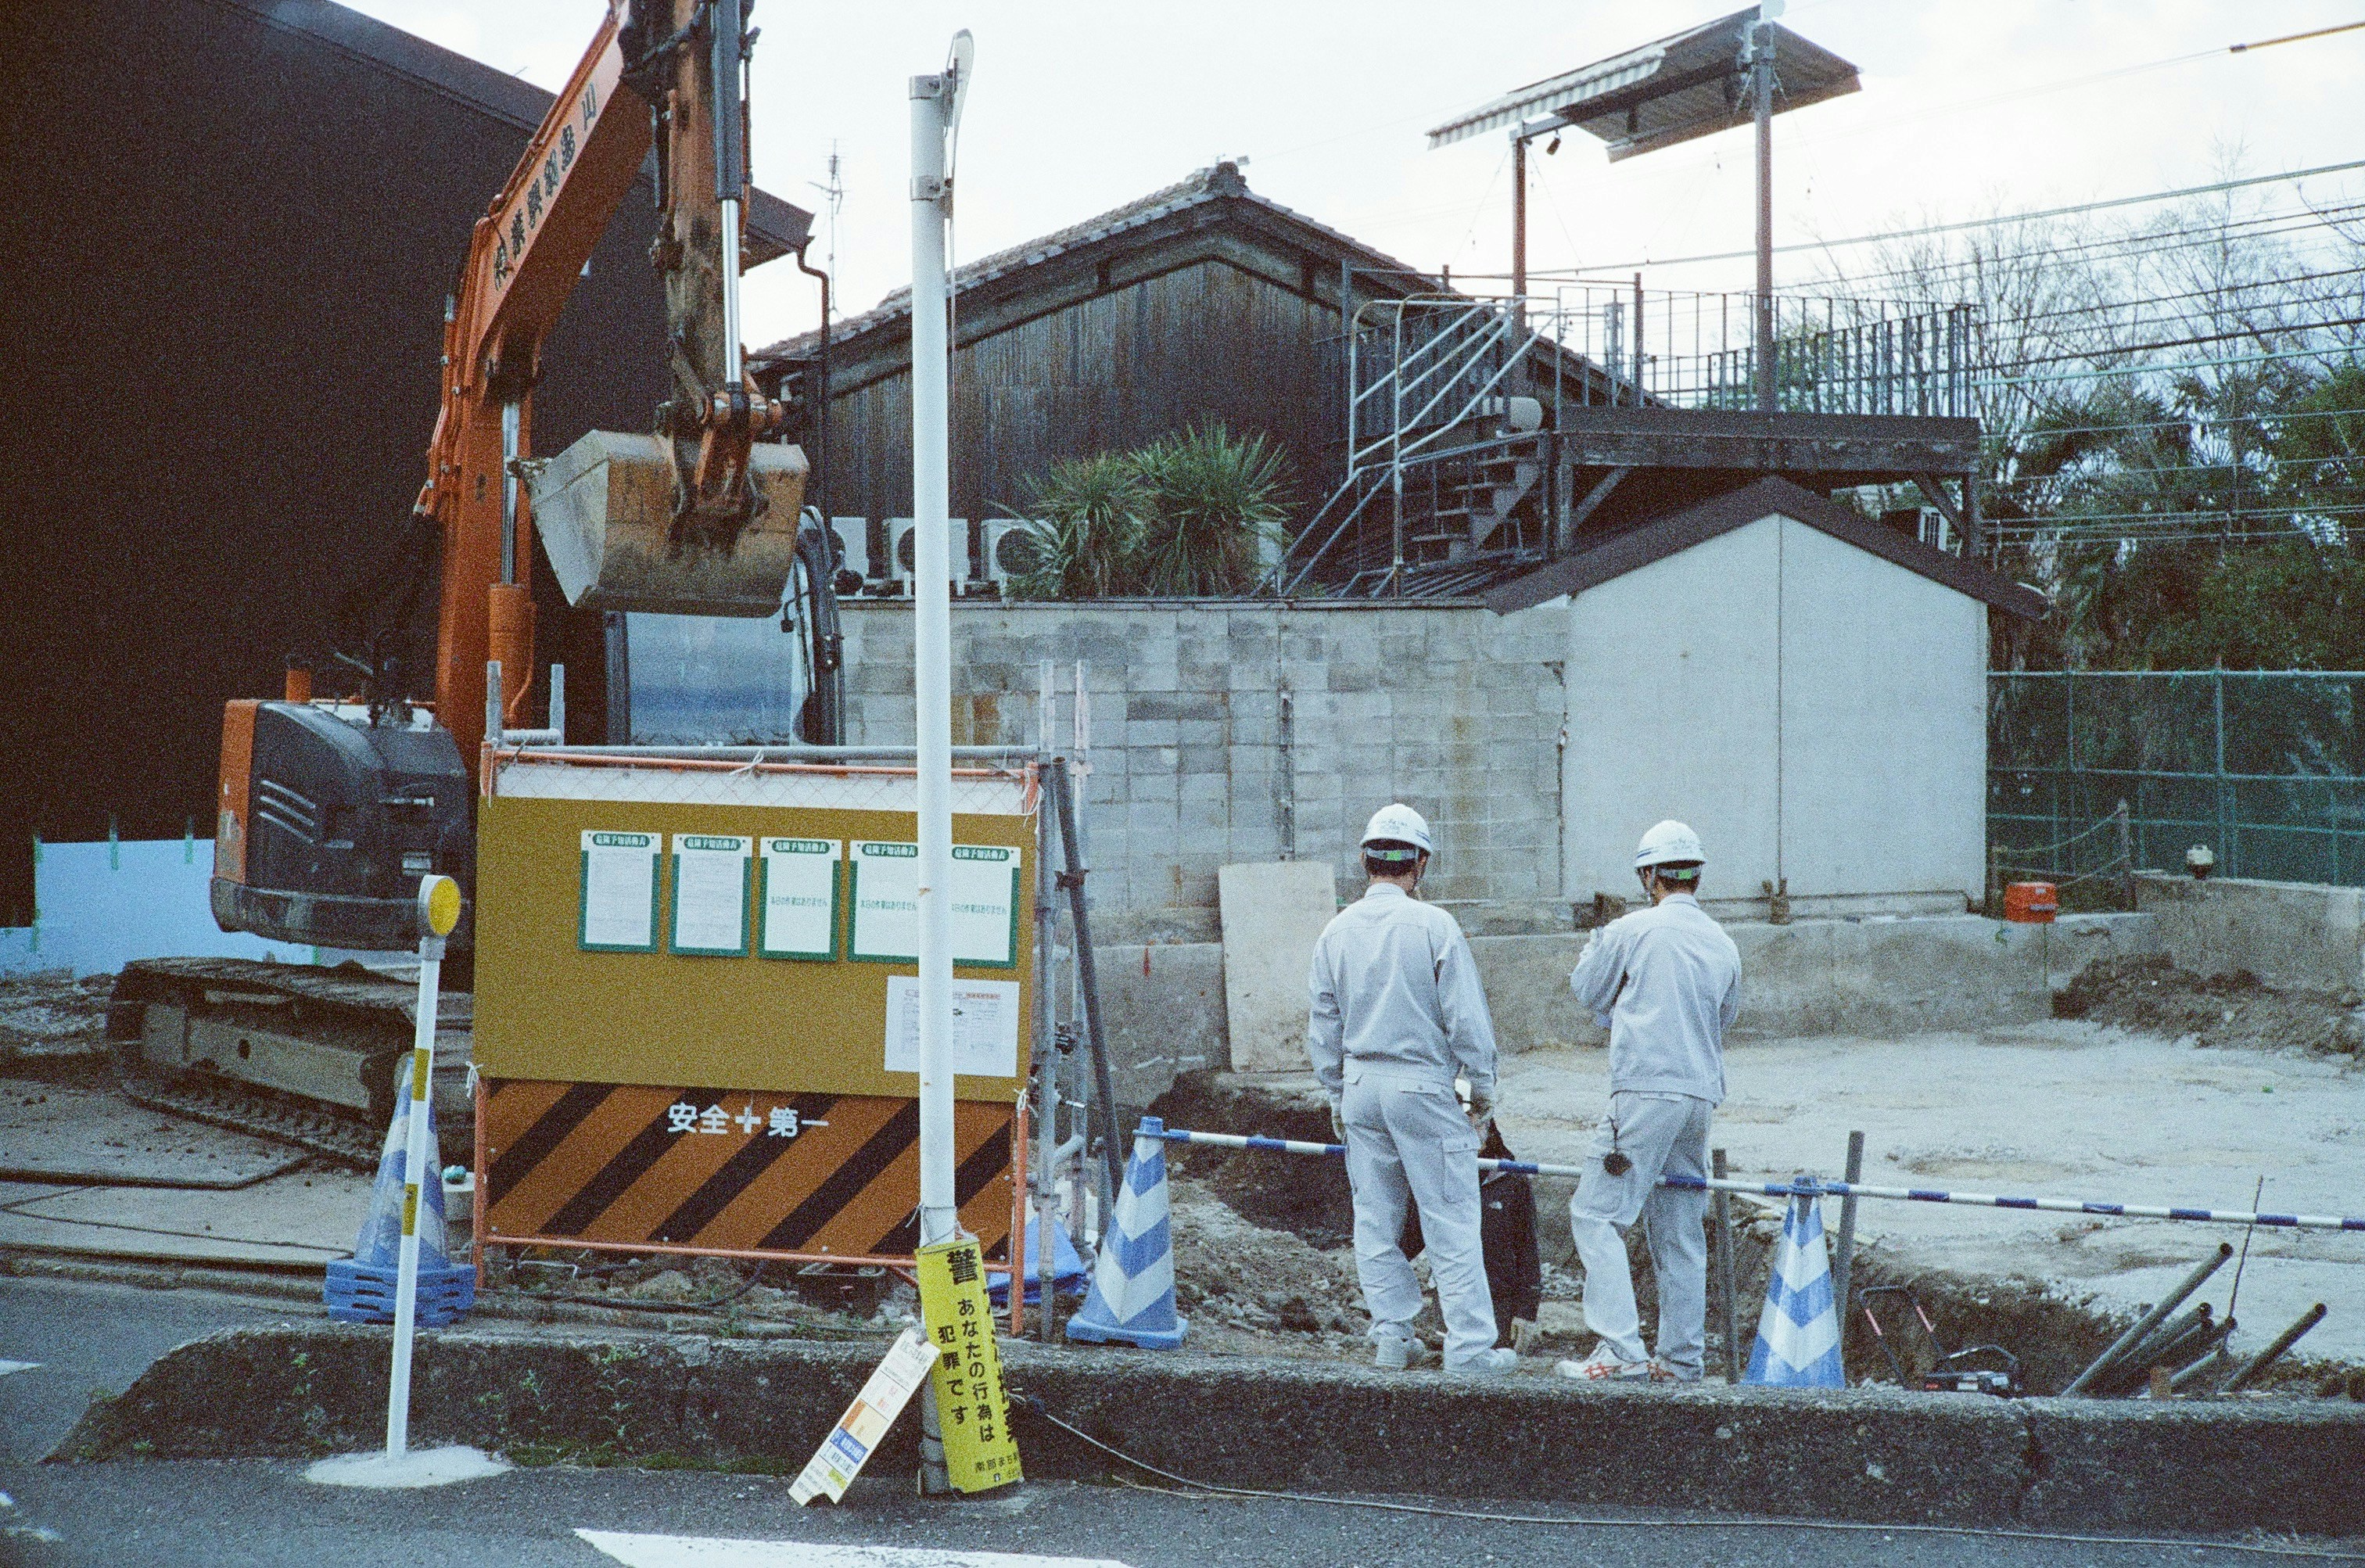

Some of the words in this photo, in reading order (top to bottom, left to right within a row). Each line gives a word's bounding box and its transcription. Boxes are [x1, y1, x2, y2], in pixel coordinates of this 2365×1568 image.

[667, 1101, 730, 1135] 安全
[767, 1106, 830, 1138] 第一
[938, 1325, 969, 1425] 犯罪です
[956, 1298, 996, 1443] あなたの行為は
